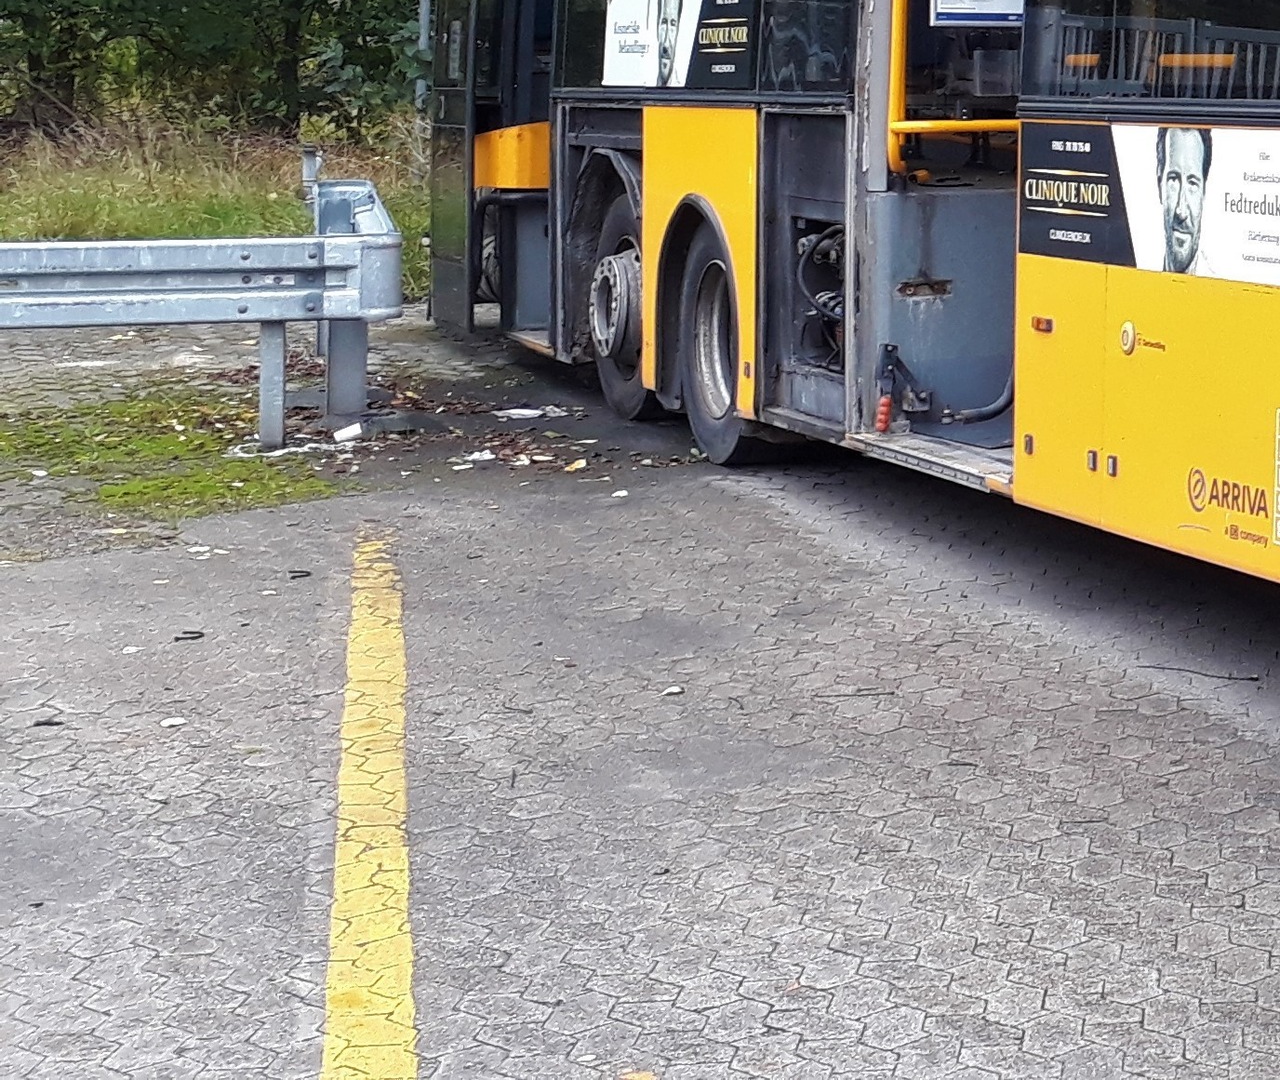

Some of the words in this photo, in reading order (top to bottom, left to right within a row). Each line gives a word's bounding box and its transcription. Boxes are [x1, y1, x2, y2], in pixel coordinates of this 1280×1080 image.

[1025, 179, 1078, 207] CLINIQUE
[1080, 182, 1110, 206] NOIR
[1208, 477, 1269, 519] ARRIVA
[1240, 530, 1269, 548] company
